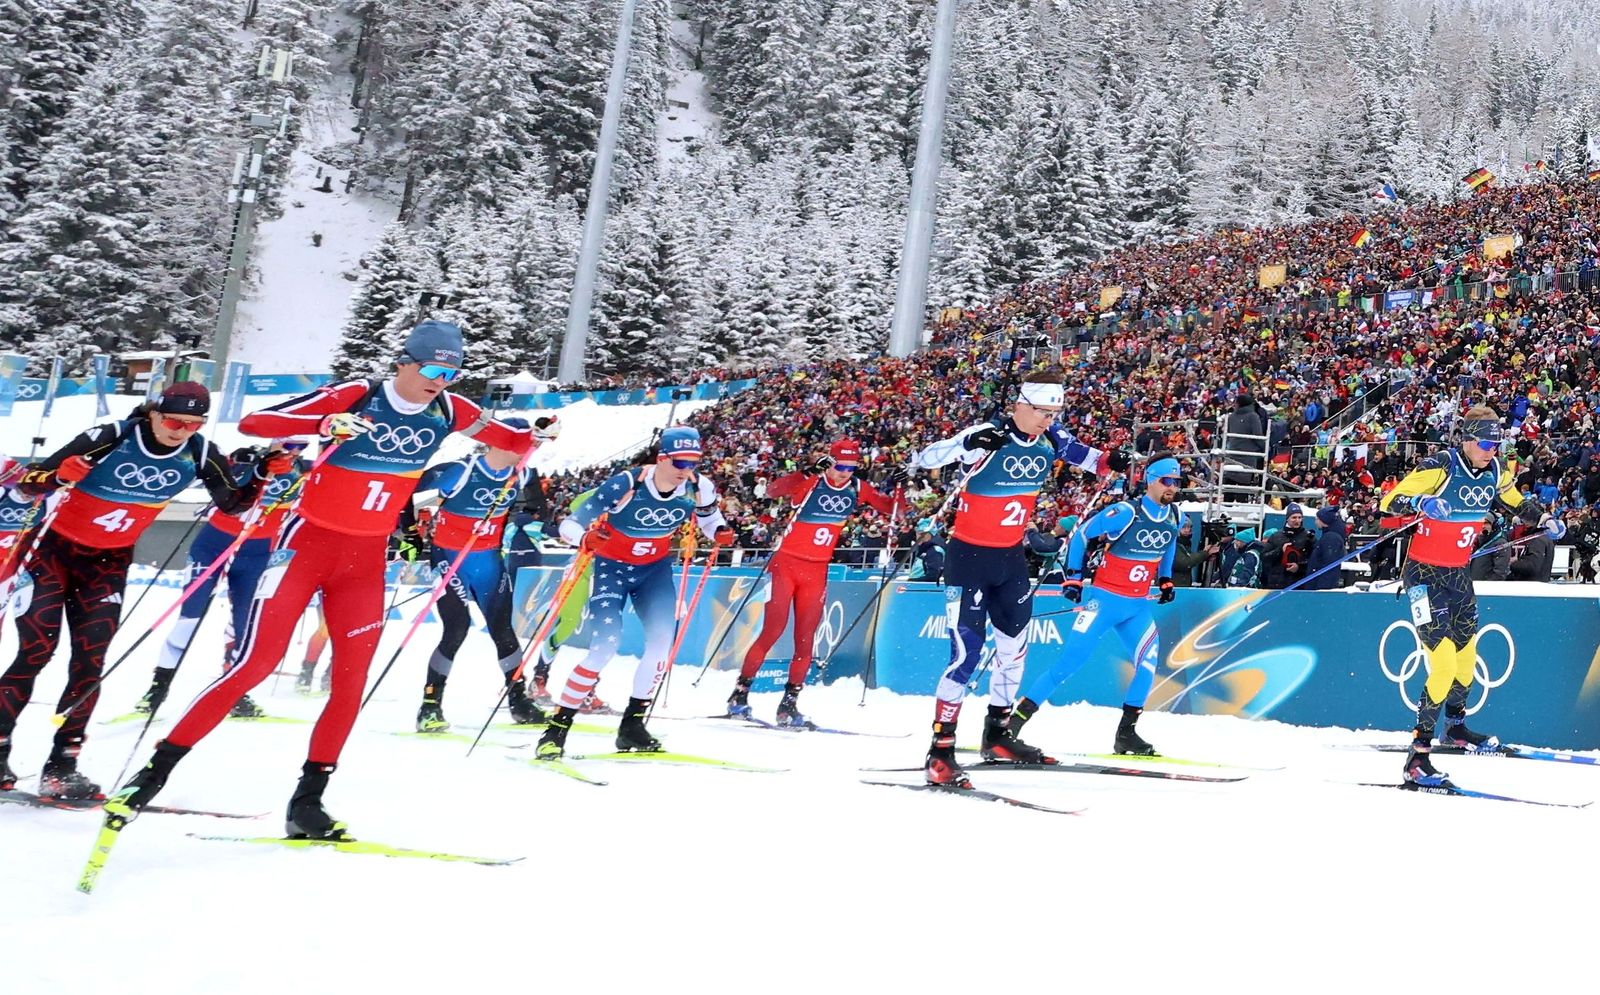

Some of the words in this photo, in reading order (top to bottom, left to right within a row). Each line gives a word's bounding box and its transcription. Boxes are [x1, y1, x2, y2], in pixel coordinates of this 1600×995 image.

[673, 438, 700, 449] USA
[437, 560, 469, 607] ESONIA
[1414, 606, 1422, 619] 3
[1077, 614, 1086, 625] 6
[1464, 750, 1507, 758] SALOMON
